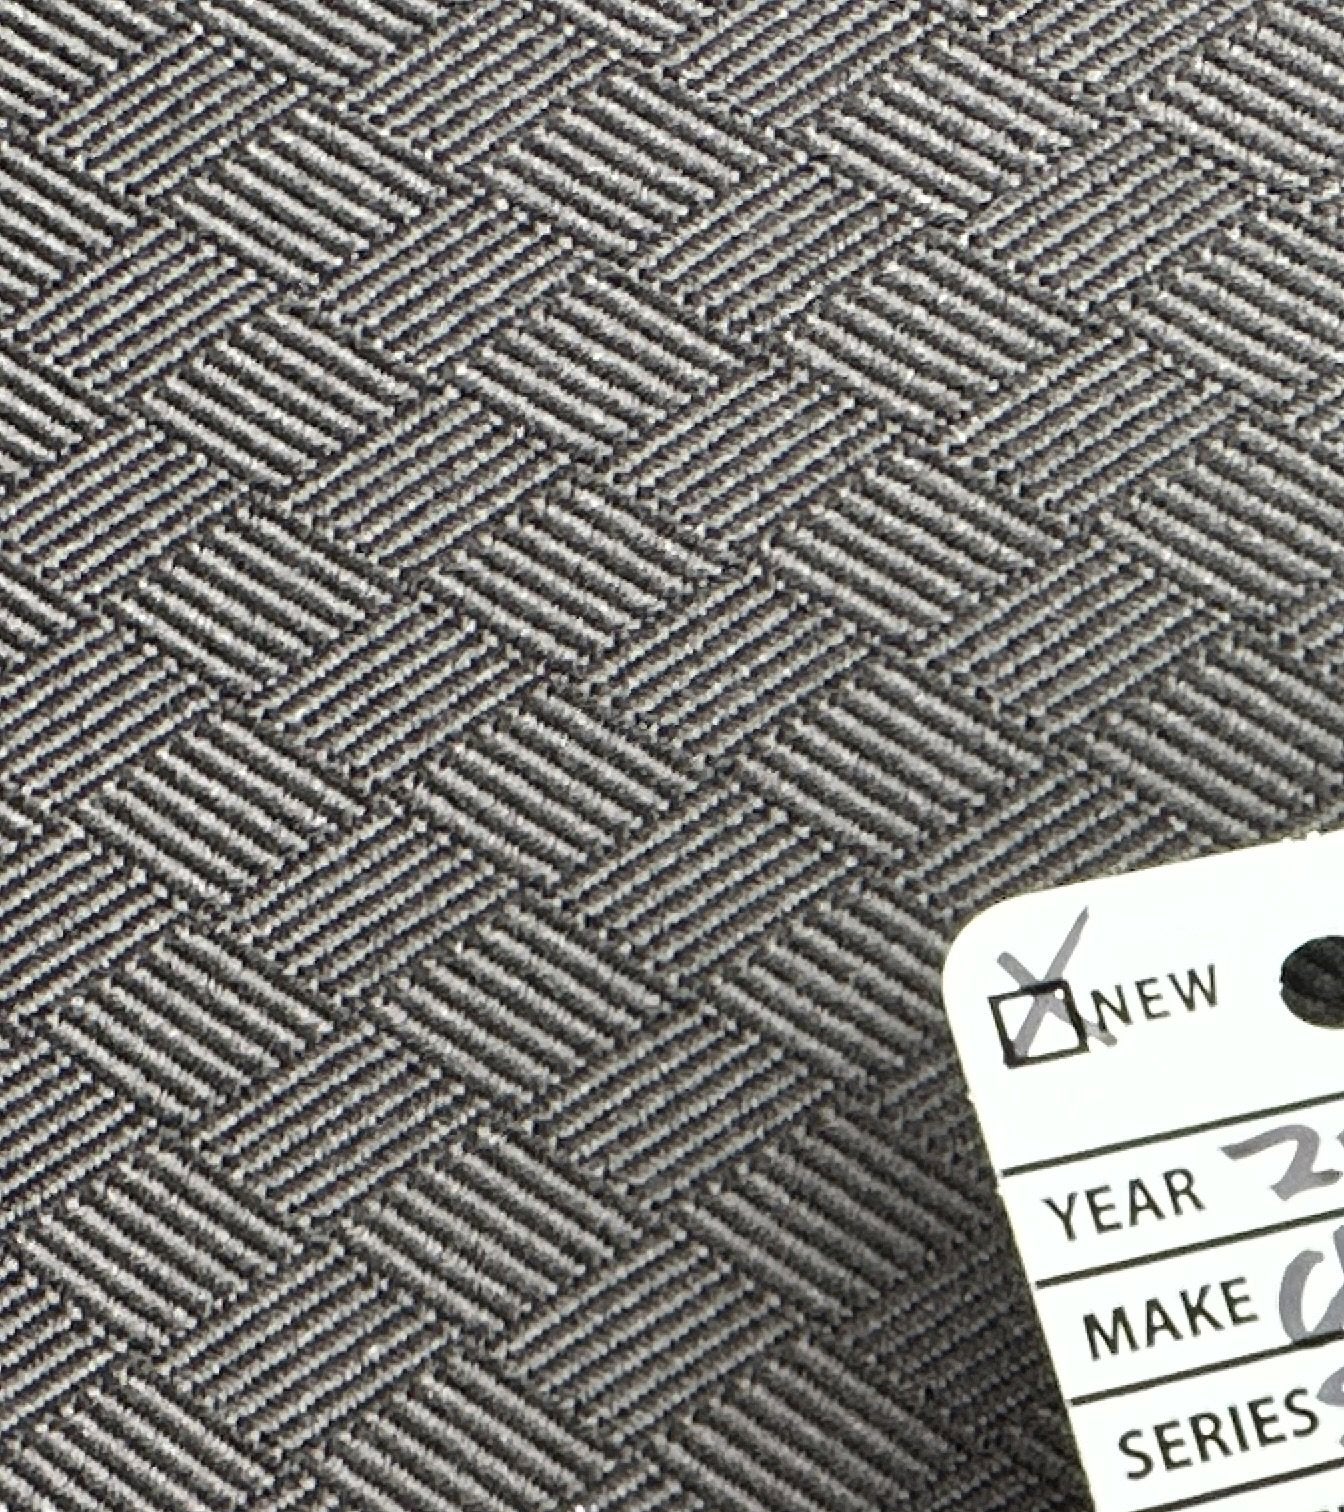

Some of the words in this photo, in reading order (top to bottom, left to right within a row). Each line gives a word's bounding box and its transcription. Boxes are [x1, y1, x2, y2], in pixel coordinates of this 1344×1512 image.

[1091, 964, 1220, 1032] NEW
[1042, 1168, 1206, 1243] YEAR
[1082, 1277, 1260, 1362] MAKE
[1117, 1388, 1321, 1481] SERIES
